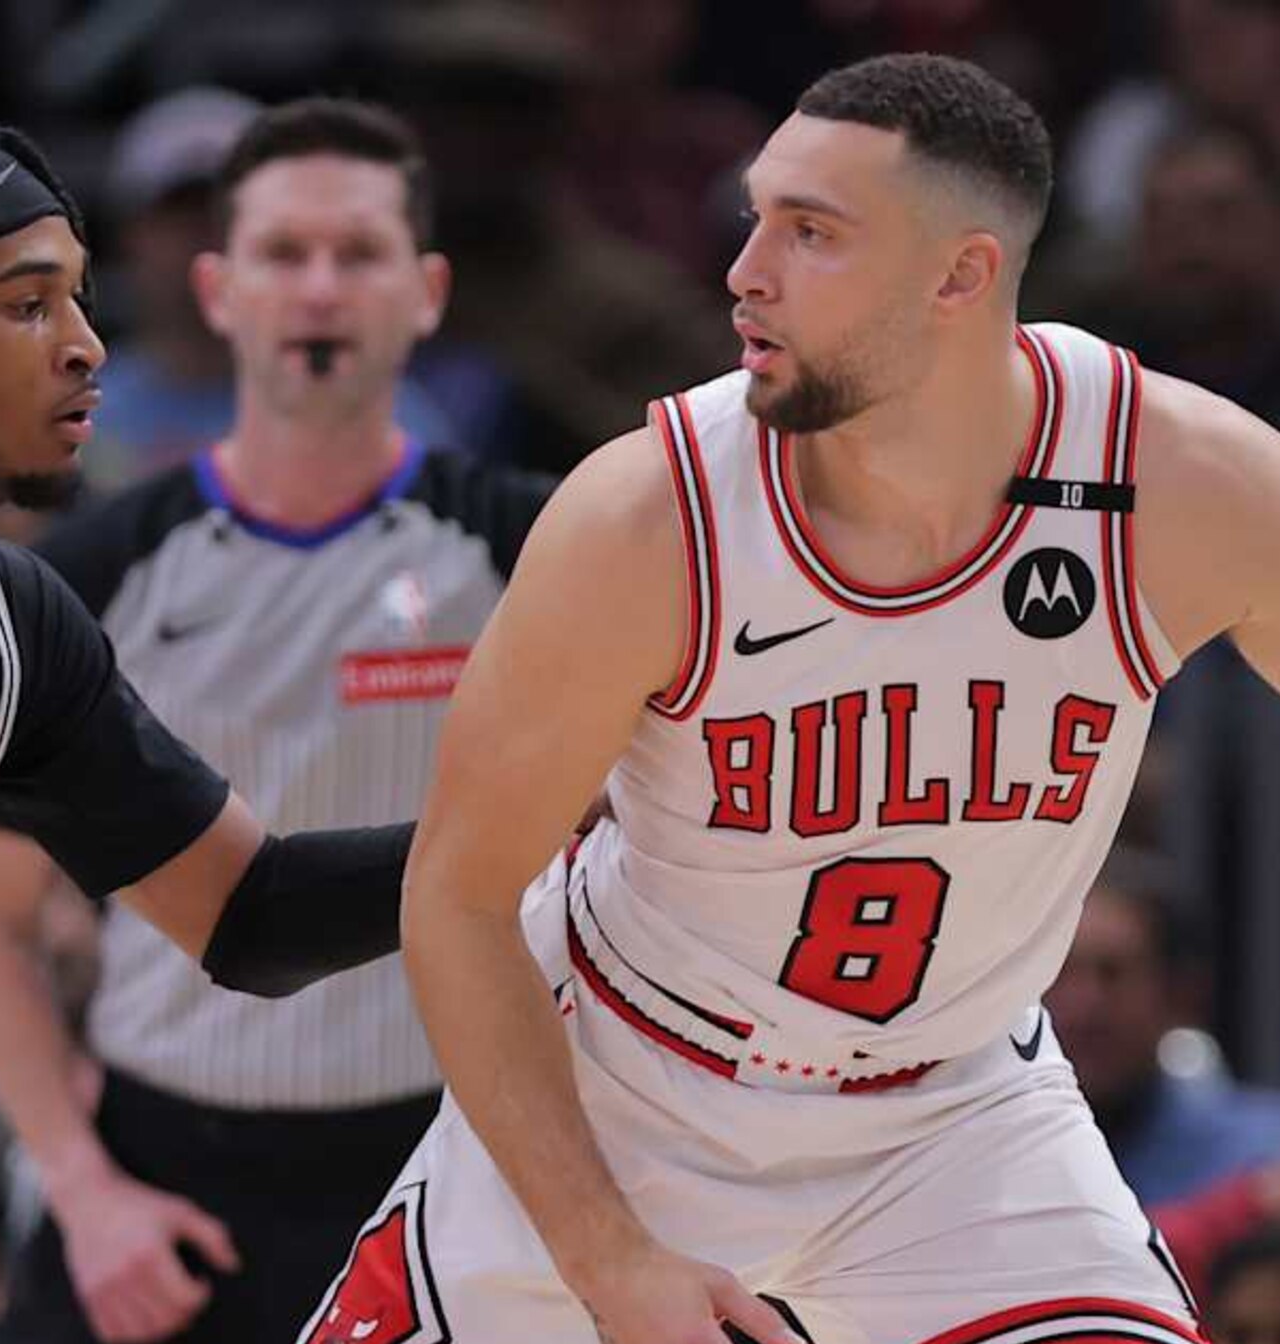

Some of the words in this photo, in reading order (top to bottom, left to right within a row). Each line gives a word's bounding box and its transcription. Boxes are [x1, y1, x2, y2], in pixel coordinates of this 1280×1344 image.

[1059, 483, 1085, 508] 10
[702, 679, 1117, 839] BULLS
[778, 856, 951, 1025] 8
